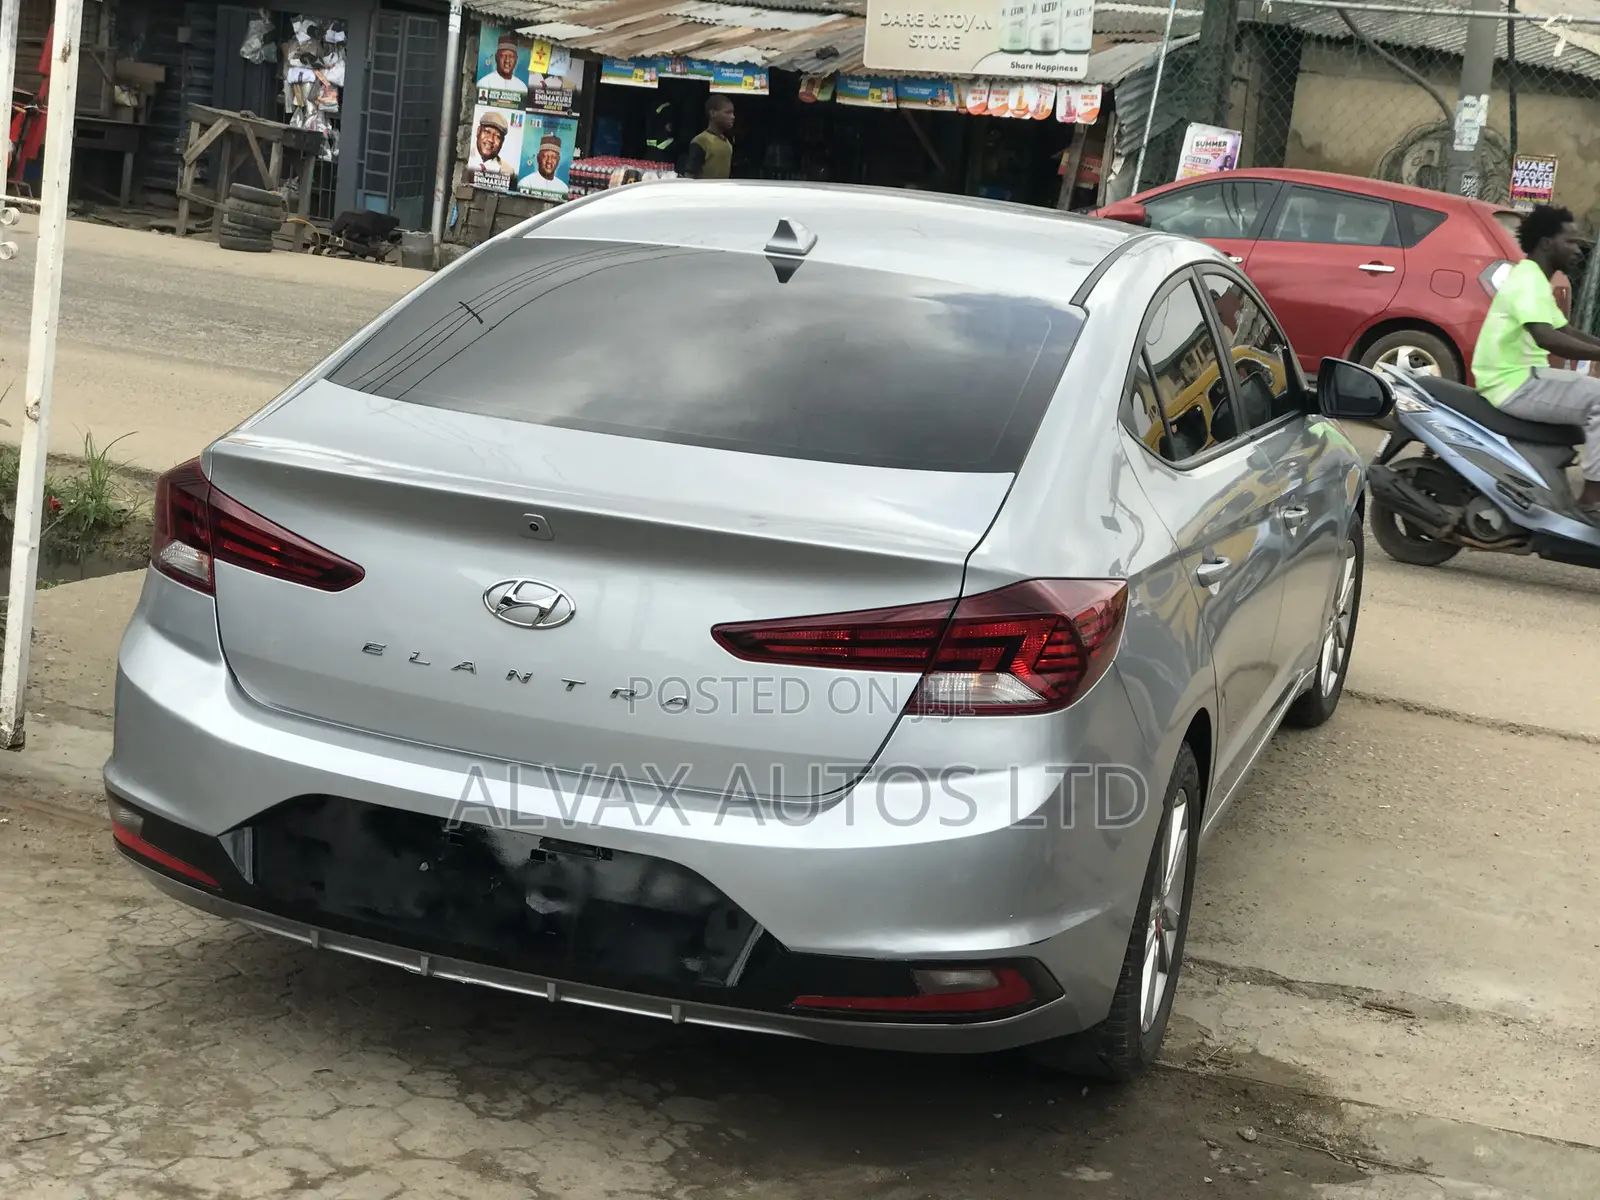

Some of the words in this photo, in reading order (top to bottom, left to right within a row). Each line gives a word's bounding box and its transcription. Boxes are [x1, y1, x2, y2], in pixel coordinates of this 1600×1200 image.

[881, 12, 924, 28] DARE
[928, 13, 940, 28] &
[908, 34, 961, 50] STORE
[1010, 61, 1033, 70] Share
[1035, 63, 1079, 73] Happiness
[1195, 140, 1228, 148] SUMMER
[1517, 160, 1554, 172] WAEC
[1513, 169, 1554, 181] NECO/GCE
[1513, 178, 1552, 189] JAMB
[362, 640, 689, 709] ELANTRA
